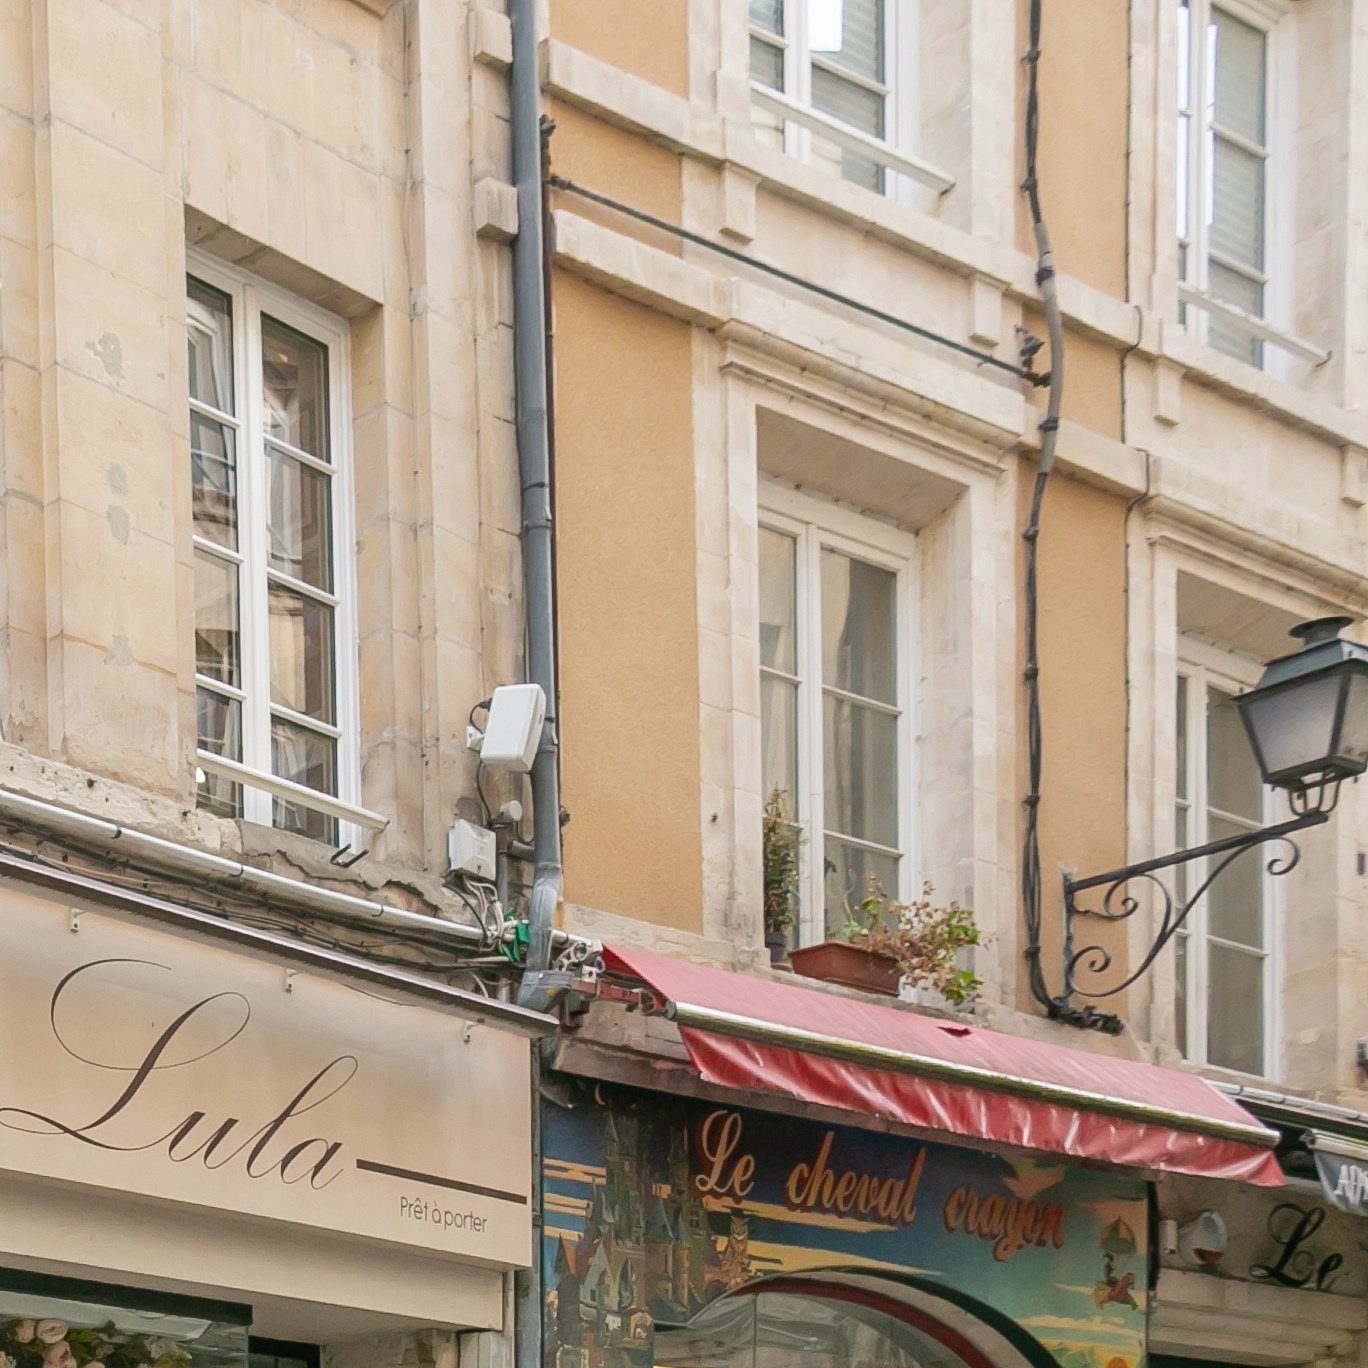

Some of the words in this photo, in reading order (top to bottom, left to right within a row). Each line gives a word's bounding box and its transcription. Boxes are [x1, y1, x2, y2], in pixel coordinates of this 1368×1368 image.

[400, 1196, 429, 1222] Prêt
[431, 1200, 442, 1224] à
[444, 1210, 488, 1233] porter
[695, 1109, 755, 1197] Le
[785, 1130, 928, 1226] cheval
[943, 1185, 1065, 1262] crayon
[1250, 1203, 1344, 1291] Le
